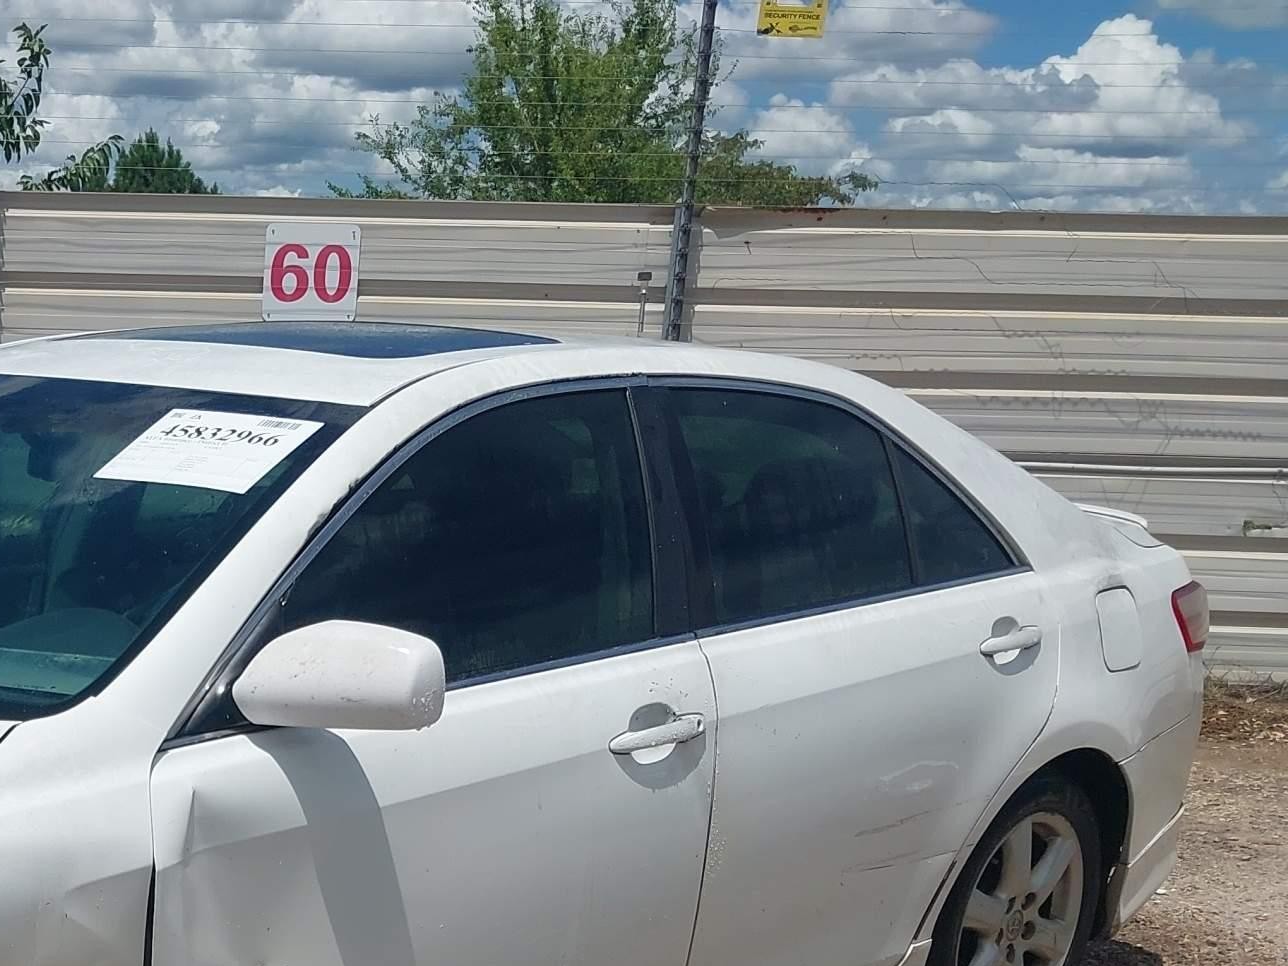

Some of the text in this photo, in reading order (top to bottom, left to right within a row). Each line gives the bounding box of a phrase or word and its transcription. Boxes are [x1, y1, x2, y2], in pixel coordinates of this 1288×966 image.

[764, 12, 798, 20] SECURITY
[269, 243, 353, 304] 60
[159, 423, 285, 448] 45832966
